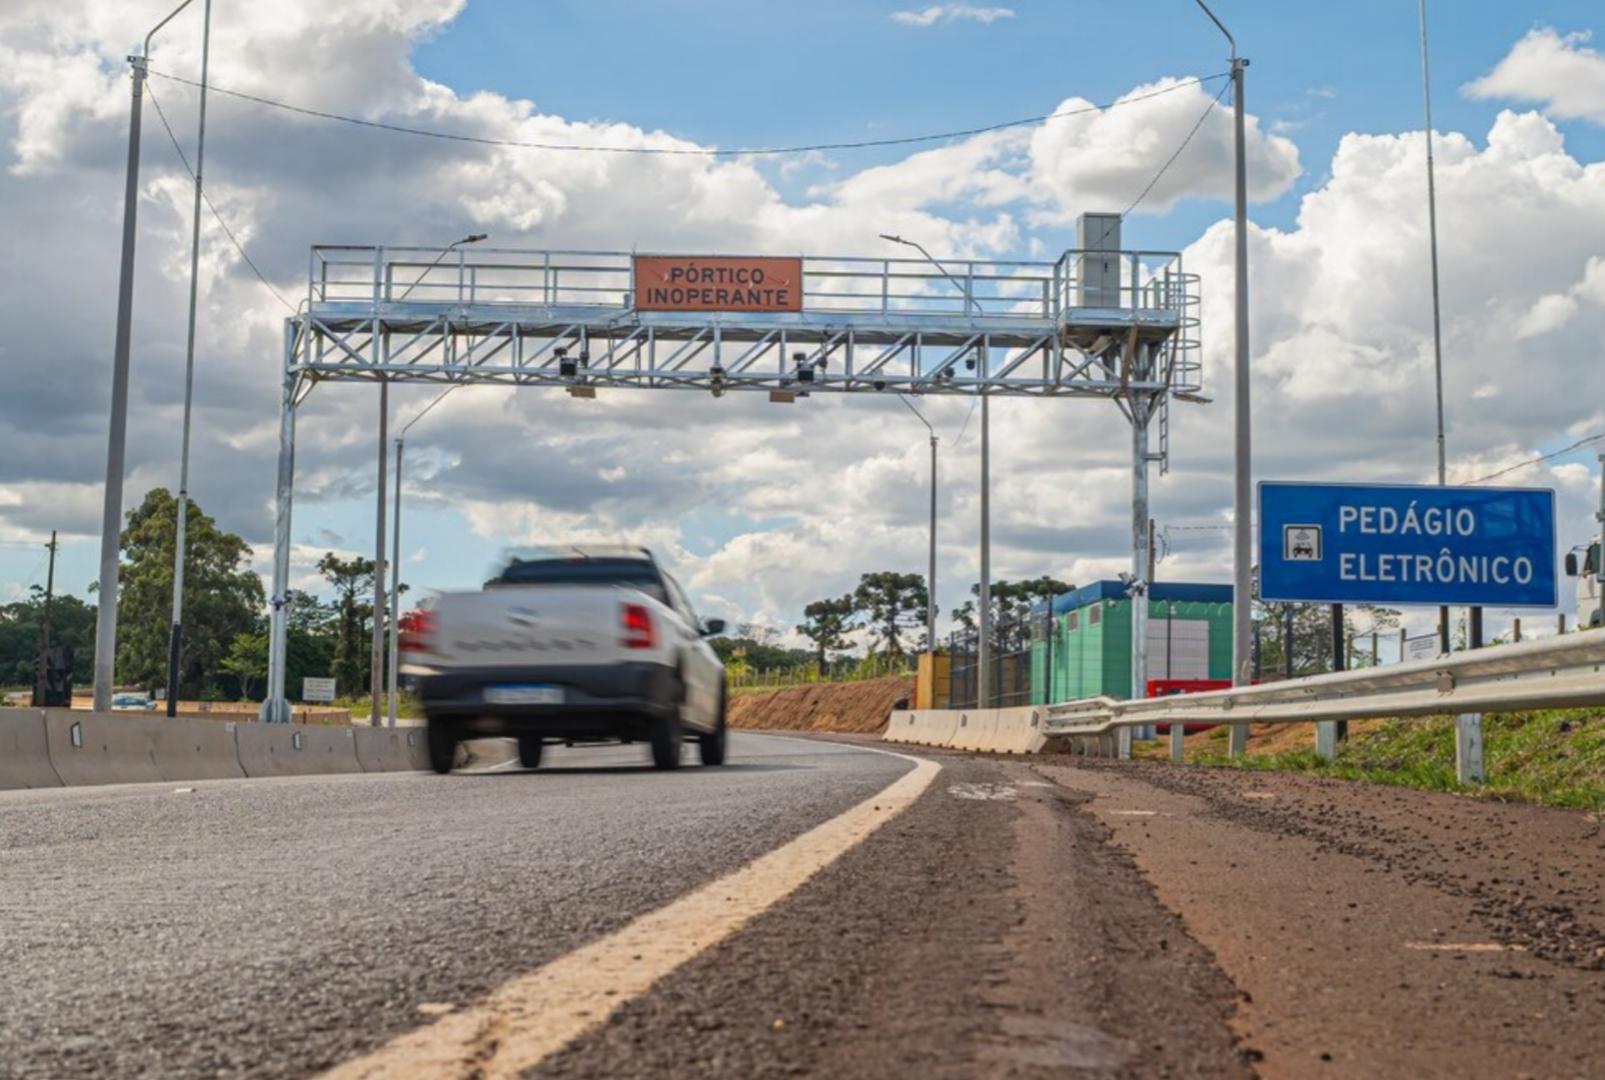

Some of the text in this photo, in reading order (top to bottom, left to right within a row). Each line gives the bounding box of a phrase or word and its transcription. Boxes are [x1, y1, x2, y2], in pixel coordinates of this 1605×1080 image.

[671, 263, 765, 284] PÓRTICO
[648, 288, 788, 306] INOPERANTE
[1339, 501, 1475, 535] PEDÁGIO
[1340, 548, 1533, 584] ELETRÔNICO
